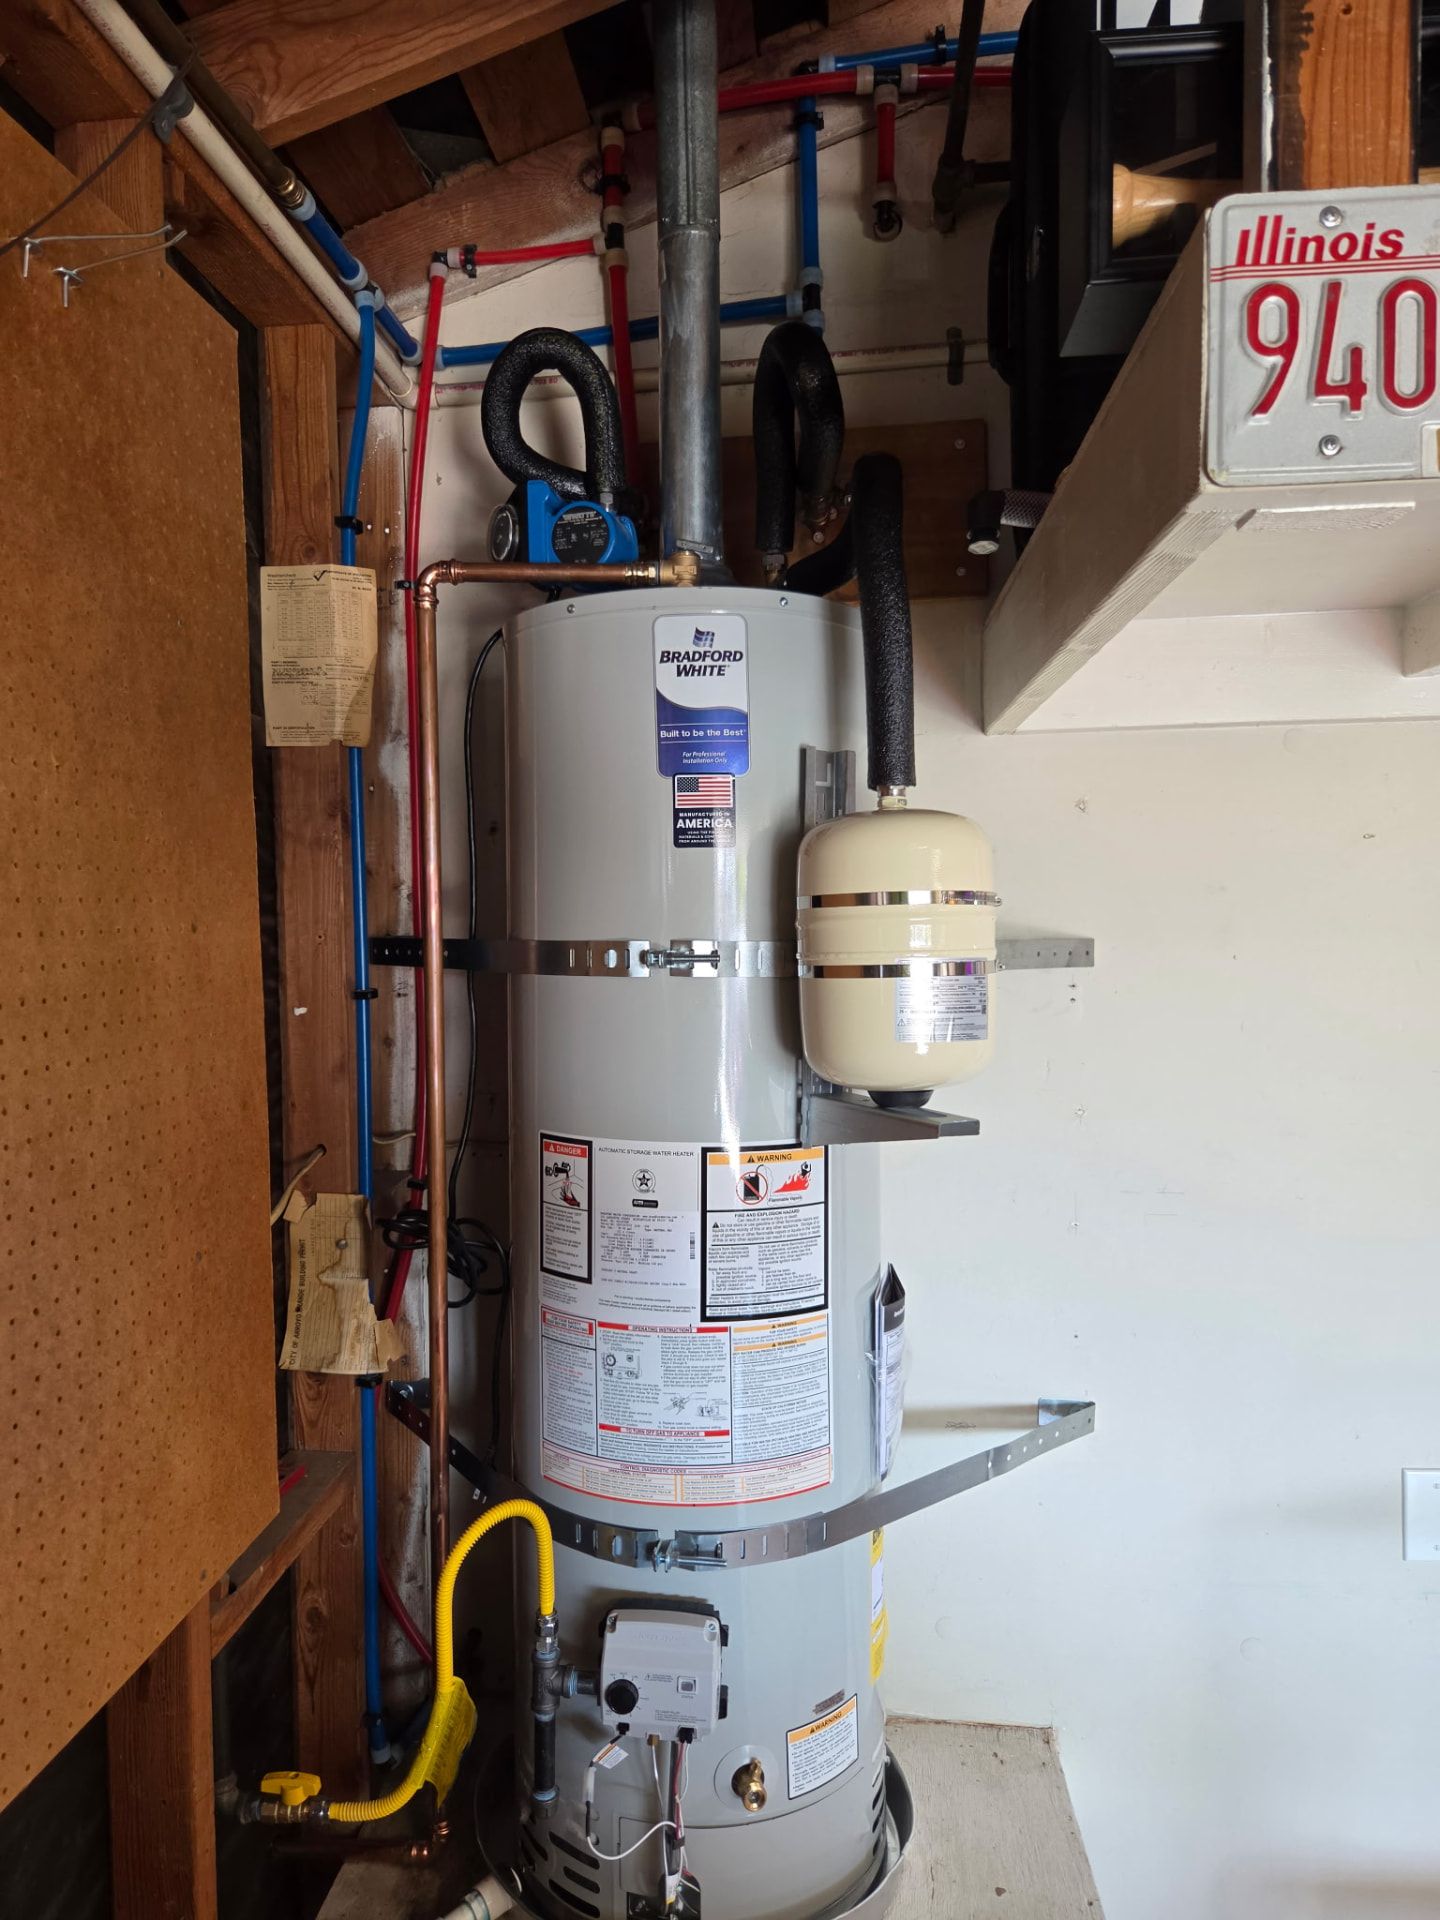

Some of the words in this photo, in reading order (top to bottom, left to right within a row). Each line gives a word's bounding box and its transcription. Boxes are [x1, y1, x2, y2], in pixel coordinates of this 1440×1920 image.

[1235, 215, 1405, 266] Illinois
[1246, 279, 1437, 416] 940
[659, 650, 744, 664] BRADFORD
[676, 664, 726, 677] WHITE
[724, 728, 743, 736] Best
[676, 819, 733, 828] AMERICA
[556, 1145, 582, 1155] DANGER
[757, 1153, 792, 1162] WARNING
[294, 1314, 302, 1338] ARROYO
[815, 1711, 842, 1730] WARNING
